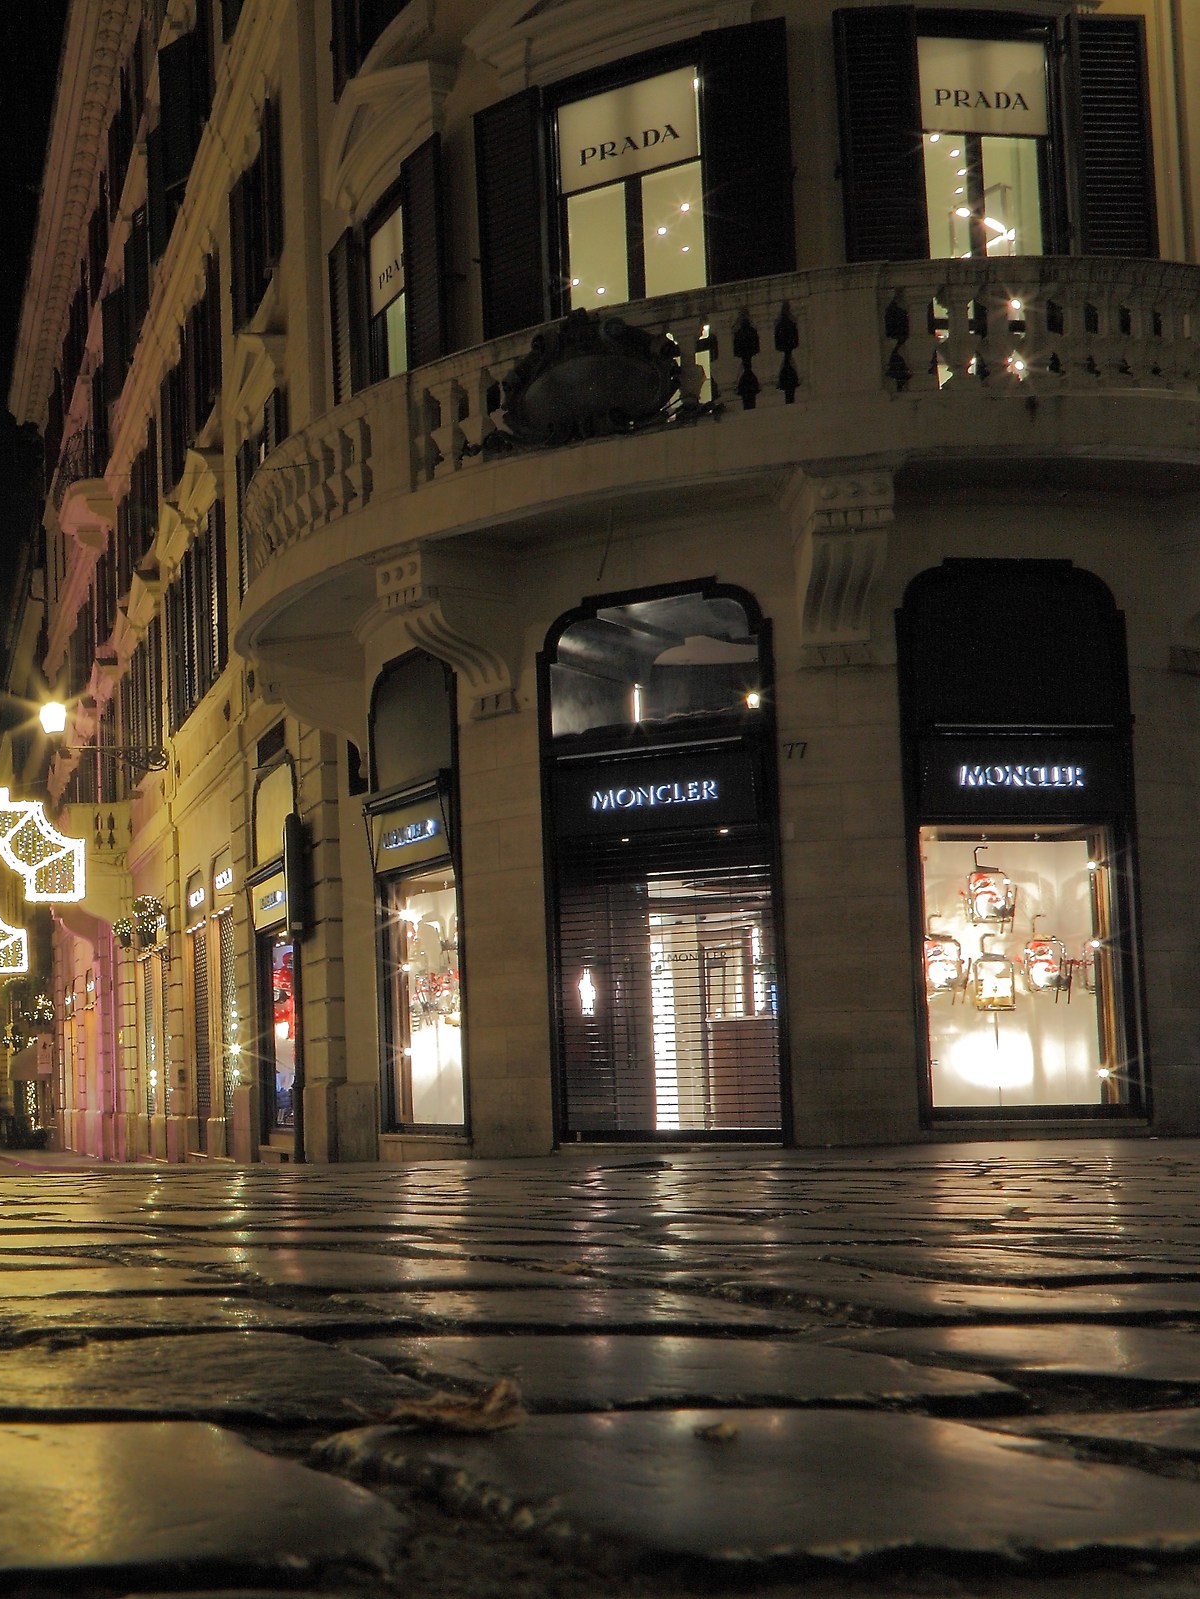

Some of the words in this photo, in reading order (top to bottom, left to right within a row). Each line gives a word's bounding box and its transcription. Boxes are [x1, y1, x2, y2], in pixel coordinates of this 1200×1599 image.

[934, 88, 1029, 111] PRADA
[579, 123, 681, 167] PRADA
[783, 742, 808, 760] 77
[958, 765, 1086, 788] MONCLER
[591, 778, 720, 811] MONCLER
